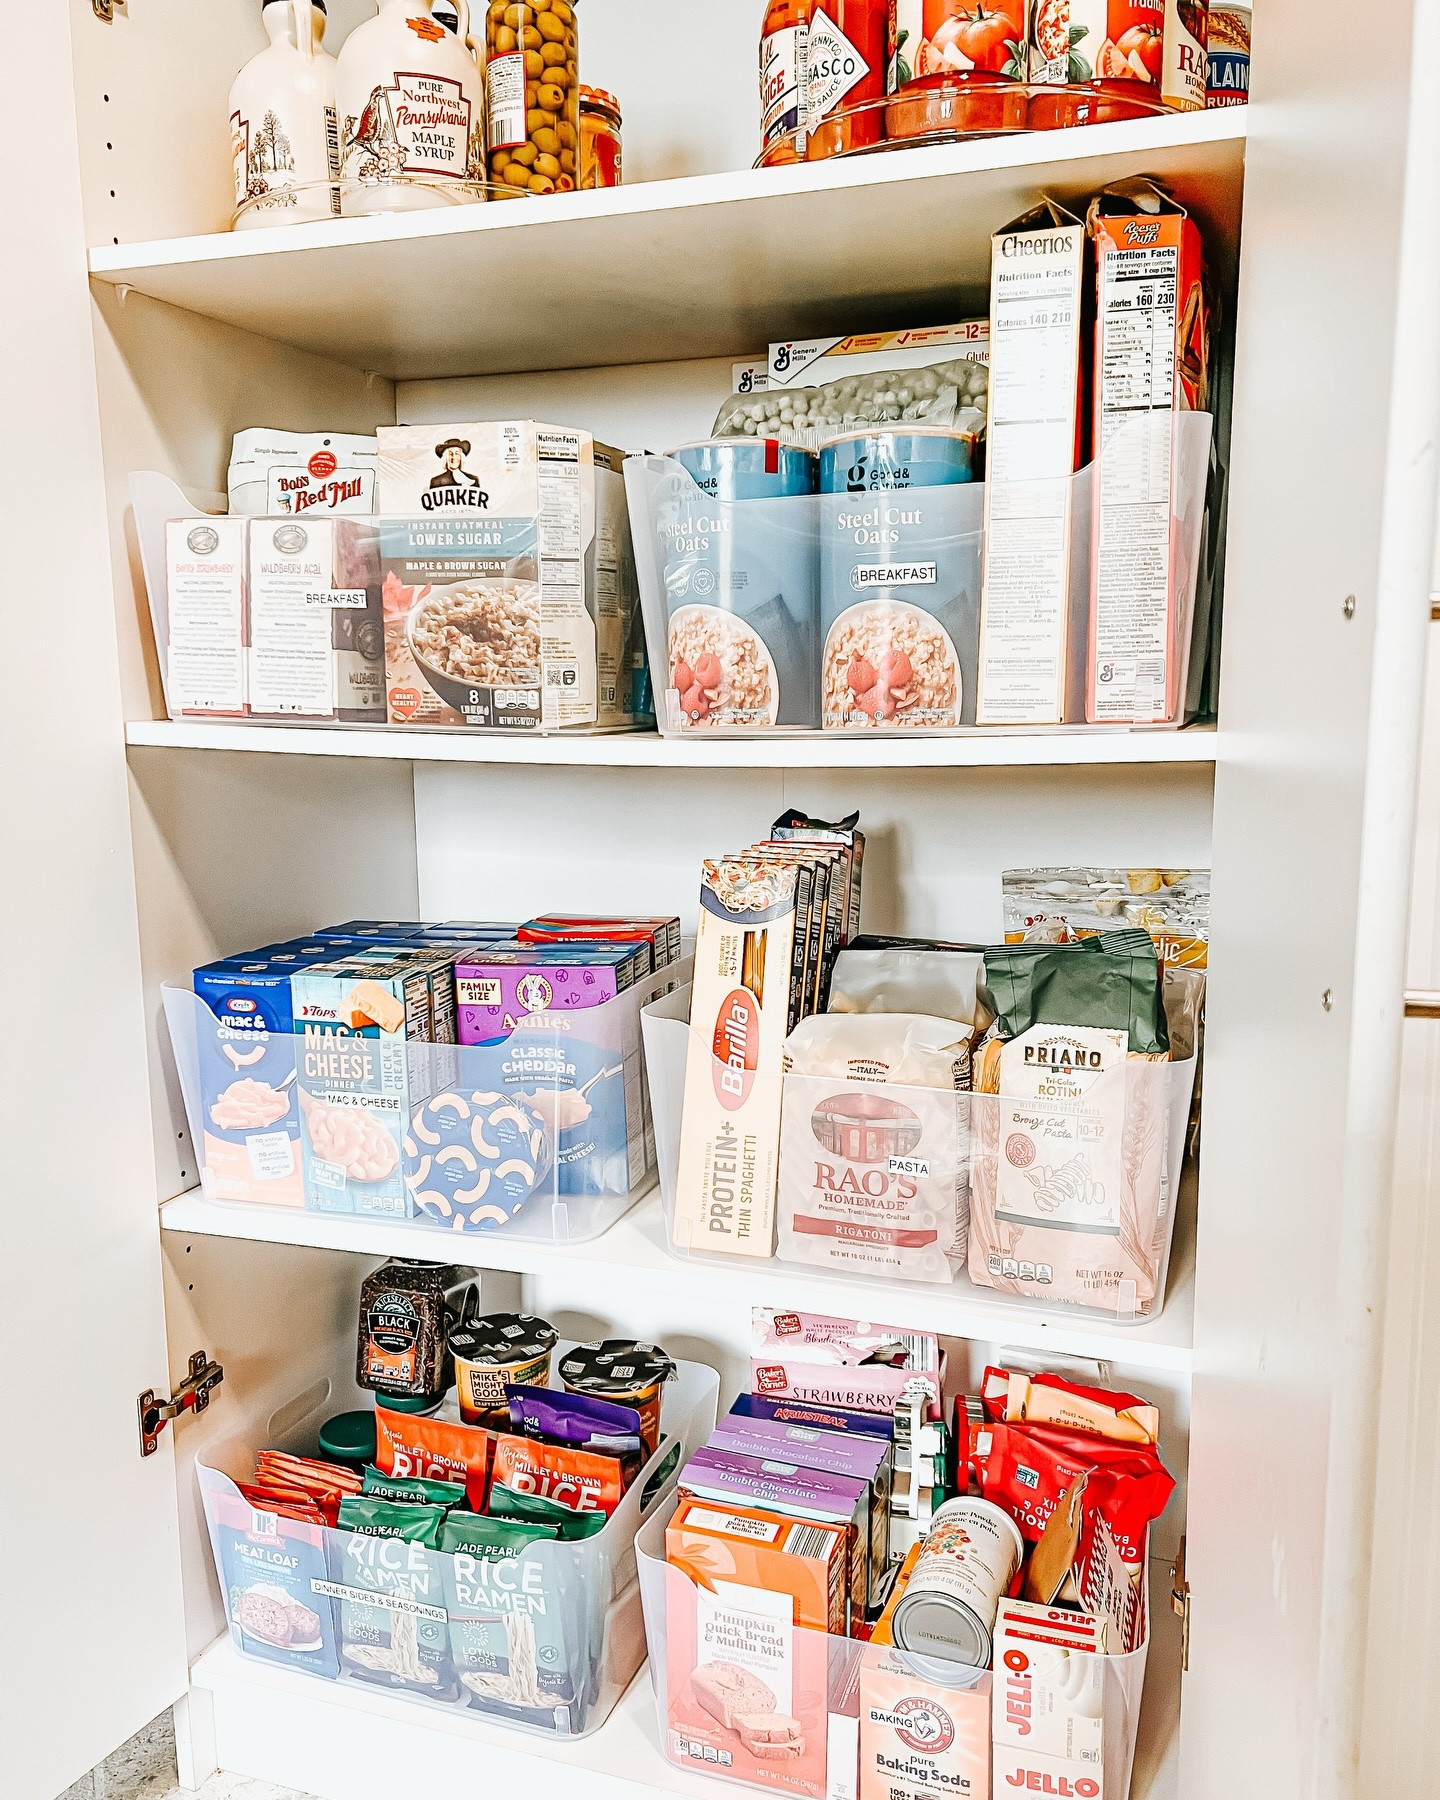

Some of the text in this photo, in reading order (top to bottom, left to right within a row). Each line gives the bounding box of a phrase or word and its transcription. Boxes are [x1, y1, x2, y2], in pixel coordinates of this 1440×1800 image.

[418, 81, 444, 93] PURE
[403, 90, 461, 110] Northwest
[396, 105, 467, 129] Pennsylvania
[412, 131, 456, 149] MAPLE
[415, 145, 455, 161] SYRUP
[1123, 221, 1161, 234] Reese's
[1001, 234, 1073, 258] Cheerios
[1127, 231, 1158, 245] Puffs
[1107, 248, 1176, 262] Nutrition Facts
[998, 268, 1073, 283] Nutrition Facts
[1106, 293, 1175, 309] Calories 160 230
[997, 312, 1072, 328] Calories 140 210
[965, 324, 980, 339] 12
[792, 347, 818, 356] General
[966, 351, 990, 362] Glute
[538, 434, 578, 444] Nutrition Facts
[563, 466, 579, 476] 120
[277, 475, 363, 514] Bob's Red Mill
[420, 488, 490, 512] QUAKER
[407, 520, 505, 531] INSTANT OATMEAL
[695, 514, 730, 534] Cut
[837, 507, 923, 531] Steel Cut
[408, 532, 502, 547] LOWER SUGAR
[674, 535, 710, 554] Oats
[853, 527, 900, 546] Oats
[405, 561, 507, 571] MAPLE & BROWN SUGAR
[860, 566, 936, 582] BREAKFAST
[306, 593, 366, 605] BREAKFAST
[391, 699, 418, 708] HEALTHY
[394, 692, 414, 700] HEART
[469, 689, 479, 705] 8
[460, 981, 497, 992] FAMILY
[467, 991, 491, 1002] SIZE
[233, 1001, 251, 1010] Kraft
[220, 1014, 266, 1029] mac &
[304, 1023, 370, 1052] MAC &
[721, 1003, 749, 1097] Barilla
[1024, 1045, 1102, 1067] PRIANO
[304, 1052, 375, 1080] CHEESE
[383, 1055, 394, 1089] THICK
[393, 1042, 404, 1090] CREAMY
[857, 1066, 878, 1075] ITALY
[874, 1060, 890, 1069] FROM
[325, 1079, 356, 1089] DINNER
[1045, 1077, 1076, 1086] Tri-Color
[1038, 1085, 1082, 1098] ROTINI
[327, 1094, 400, 1109] MAC & CHEESE
[1012, 1113, 1066, 1130] Bronze Cut
[1043, 1127, 1073, 1139] Pasta
[1078, 1125, 1105, 1137] 10-12
[889, 1158, 928, 1175] PASTA
[738, 1134, 757, 1239] THIN SPAGHETTI
[813, 1161, 918, 1199] RAO'S
[823, 1193, 906, 1211] HOMEMADE
[818, 1204, 847, 1214] Premium,
[886, 1212, 910, 1222] Crafted
[835, 1224, 893, 1242] RIGATONI
[989, 1256, 1001, 1267] 200
[1075, 1269, 1124, 1279] NET WT 16 OZ
[376, 1294, 413, 1312] RICESELECT
[378, 1315, 411, 1330] BLACK
[774, 1314, 798, 1326] Baker's
[472, 1371, 508, 1382] MIKE'S
[757, 1367, 784, 1379] Baker's
[473, 1381, 508, 1389] MIGHTY
[792, 1386, 897, 1407] STRAWBERRY
[773, 1407, 848, 1429] KRUSTEAZ
[382, 1425, 403, 1444] Organic
[393, 1443, 468, 1472] MILLET & BROWN
[503, 1446, 530, 1466] Organic
[731, 1439, 769, 1452] Double
[771, 1447, 826, 1465] Chocolate
[827, 1459, 853, 1470] Chip
[390, 1452, 467, 1482] RICE
[514, 1460, 602, 1489] MILLET & BROWN
[510, 1472, 602, 1511] RICE
[719, 1472, 759, 1487] Double
[760, 1481, 817, 1500] Chocolate
[752, 1488, 779, 1501] Chip
[368, 1486, 427, 1504] JADE PEARL
[733, 1517, 765, 1528] Pumpkin
[970, 1511, 998, 1529] Powder
[1012, 1505, 1047, 1531] ROLL
[352, 1525, 379, 1536] JADE
[234, 1540, 299, 1569] MEAT LOAF
[347, 1536, 432, 1572] RICE
[454, 1541, 518, 1558] JADE PEARL
[453, 1552, 544, 1594] RICE
[314, 1582, 445, 1620] DINNER SIDES & SEASONINGS
[455, 1583, 547, 1616] RAMEN
[348, 1617, 380, 1635] LOTUS
[713, 1611, 776, 1633] Pumpkin
[348, 1626, 381, 1642] FOODS
[705, 1622, 784, 1647] Quick Bread
[462, 1645, 497, 1661] LOTUS
[704, 1632, 785, 1659] & Muffin Mix
[463, 1654, 498, 1669] FOODS
[877, 1663, 917, 1678] Baking Soda
[1003, 1649, 1032, 1736] JELL-O
[870, 1710, 913, 1728] BAKING
[917, 1700, 951, 1737] HAMMER
[876, 1752, 971, 1788] Baking Soda
[910, 1755, 936, 1768] pure
[756, 1768, 770, 1778] NET
[771, 1771, 782, 1780] WT
[1005, 1768, 1100, 1798] JELL-O
